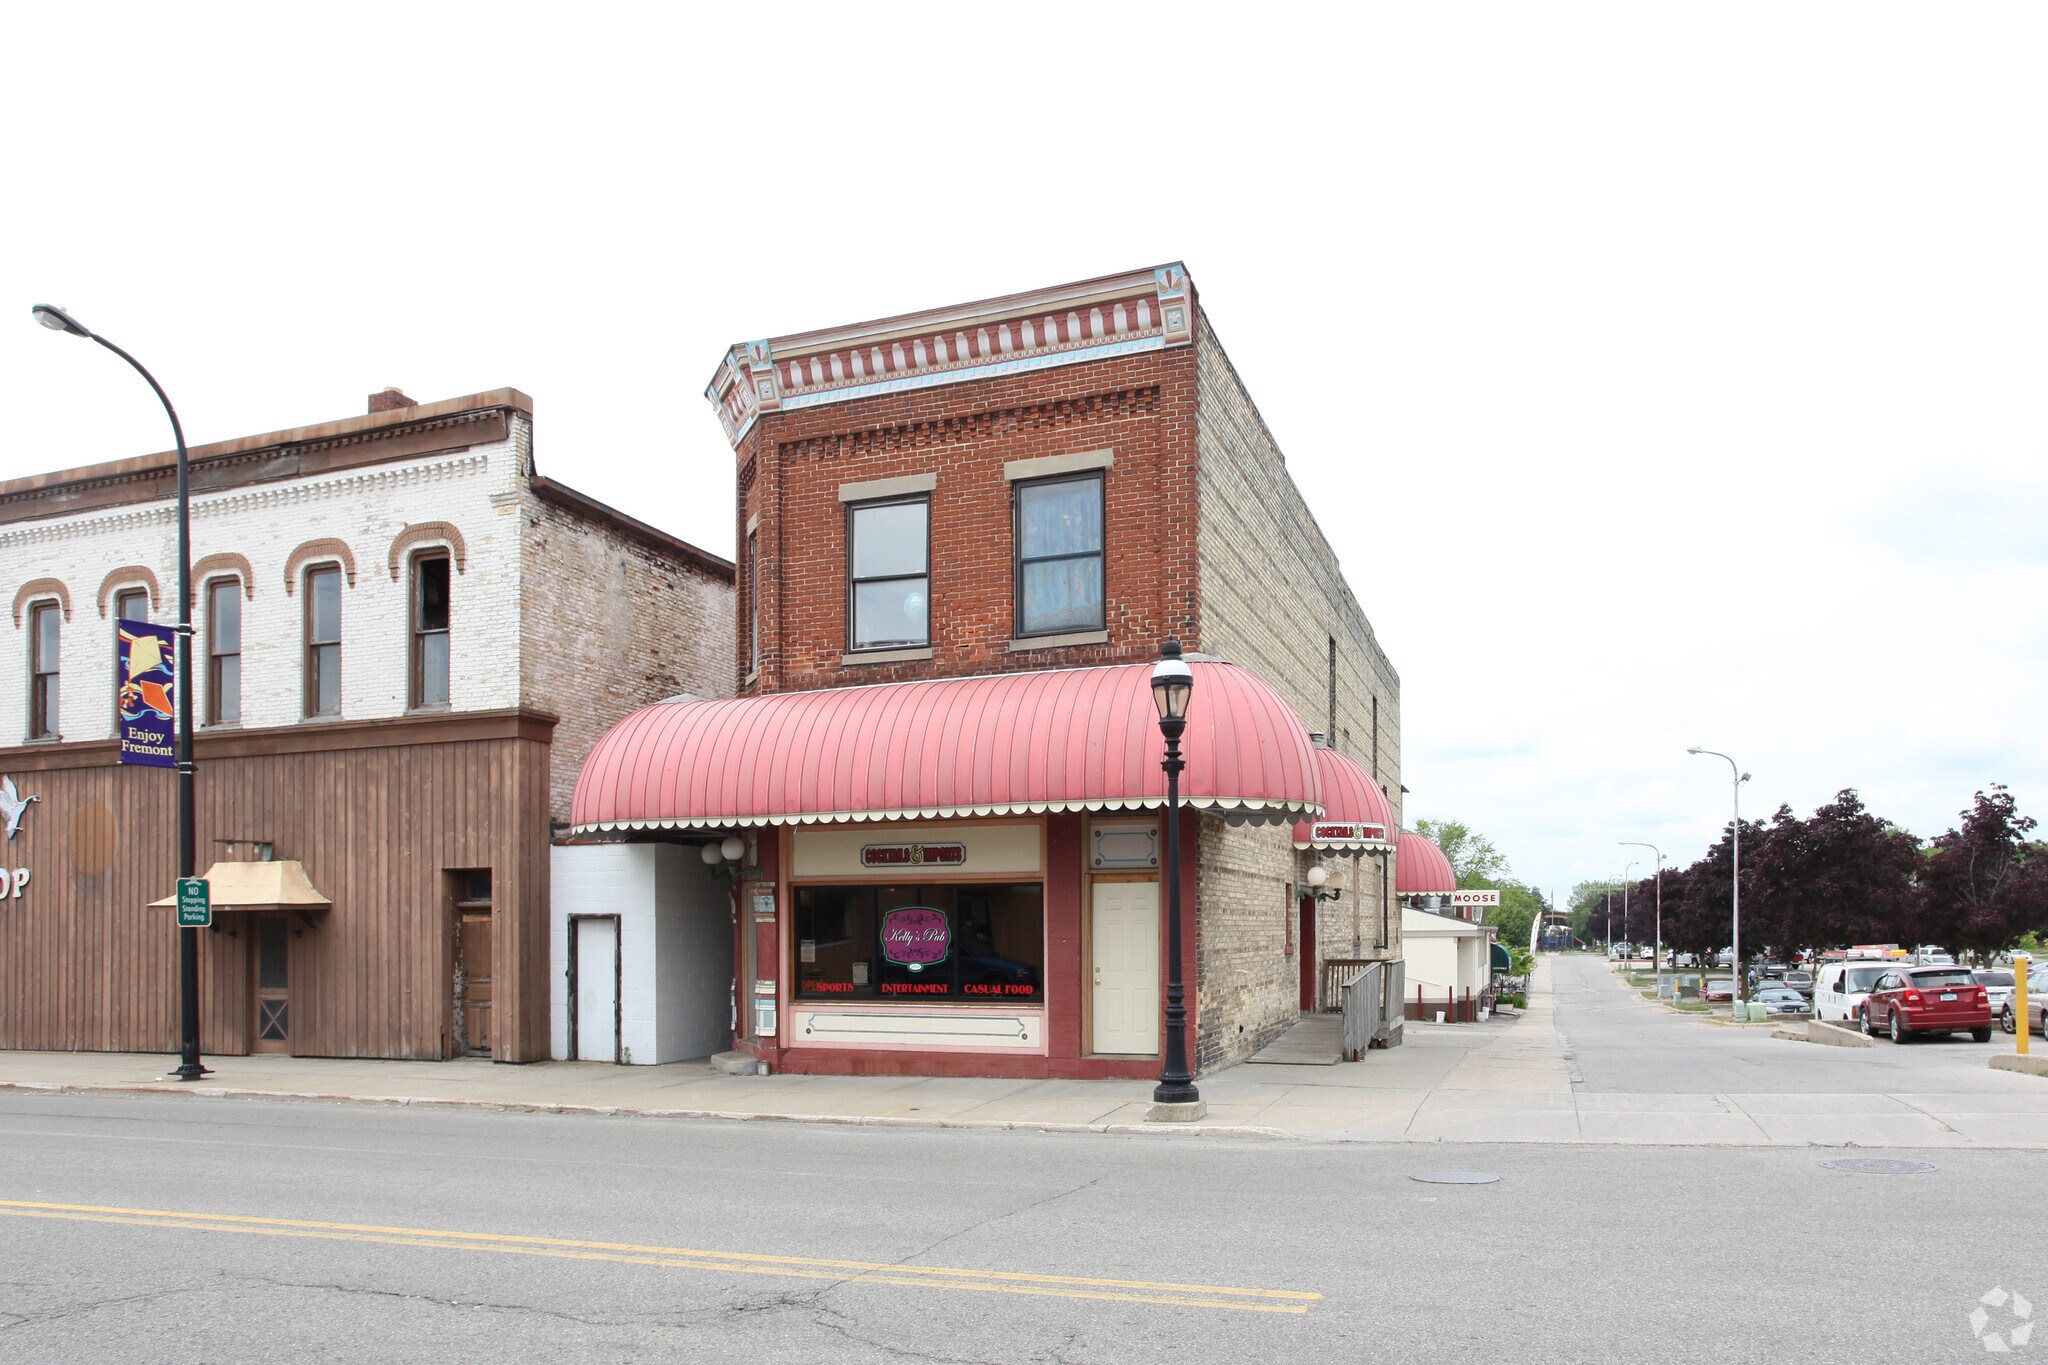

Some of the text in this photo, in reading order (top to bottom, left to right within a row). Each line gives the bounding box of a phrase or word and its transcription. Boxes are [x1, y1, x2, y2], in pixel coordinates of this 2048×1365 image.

[128, 726, 165, 745] Enjoy
[121, 739, 173, 756] Fremont
[1316, 826, 1354, 838] COCKTAILS
[1354, 824, 1363, 839] &
[865, 845, 962, 864] COCKTAILS & IMPORTS
[188, 887, 199, 895] NO
[181, 896, 205, 904] Stopping
[181, 905, 205, 913] Standing
[183, 913, 204, 921] Parking
[885, 928, 946, 947] Kelly's Pub
[816, 982, 1034, 994] SPORTS ENTERTAINMENT CASUAL FOOD
